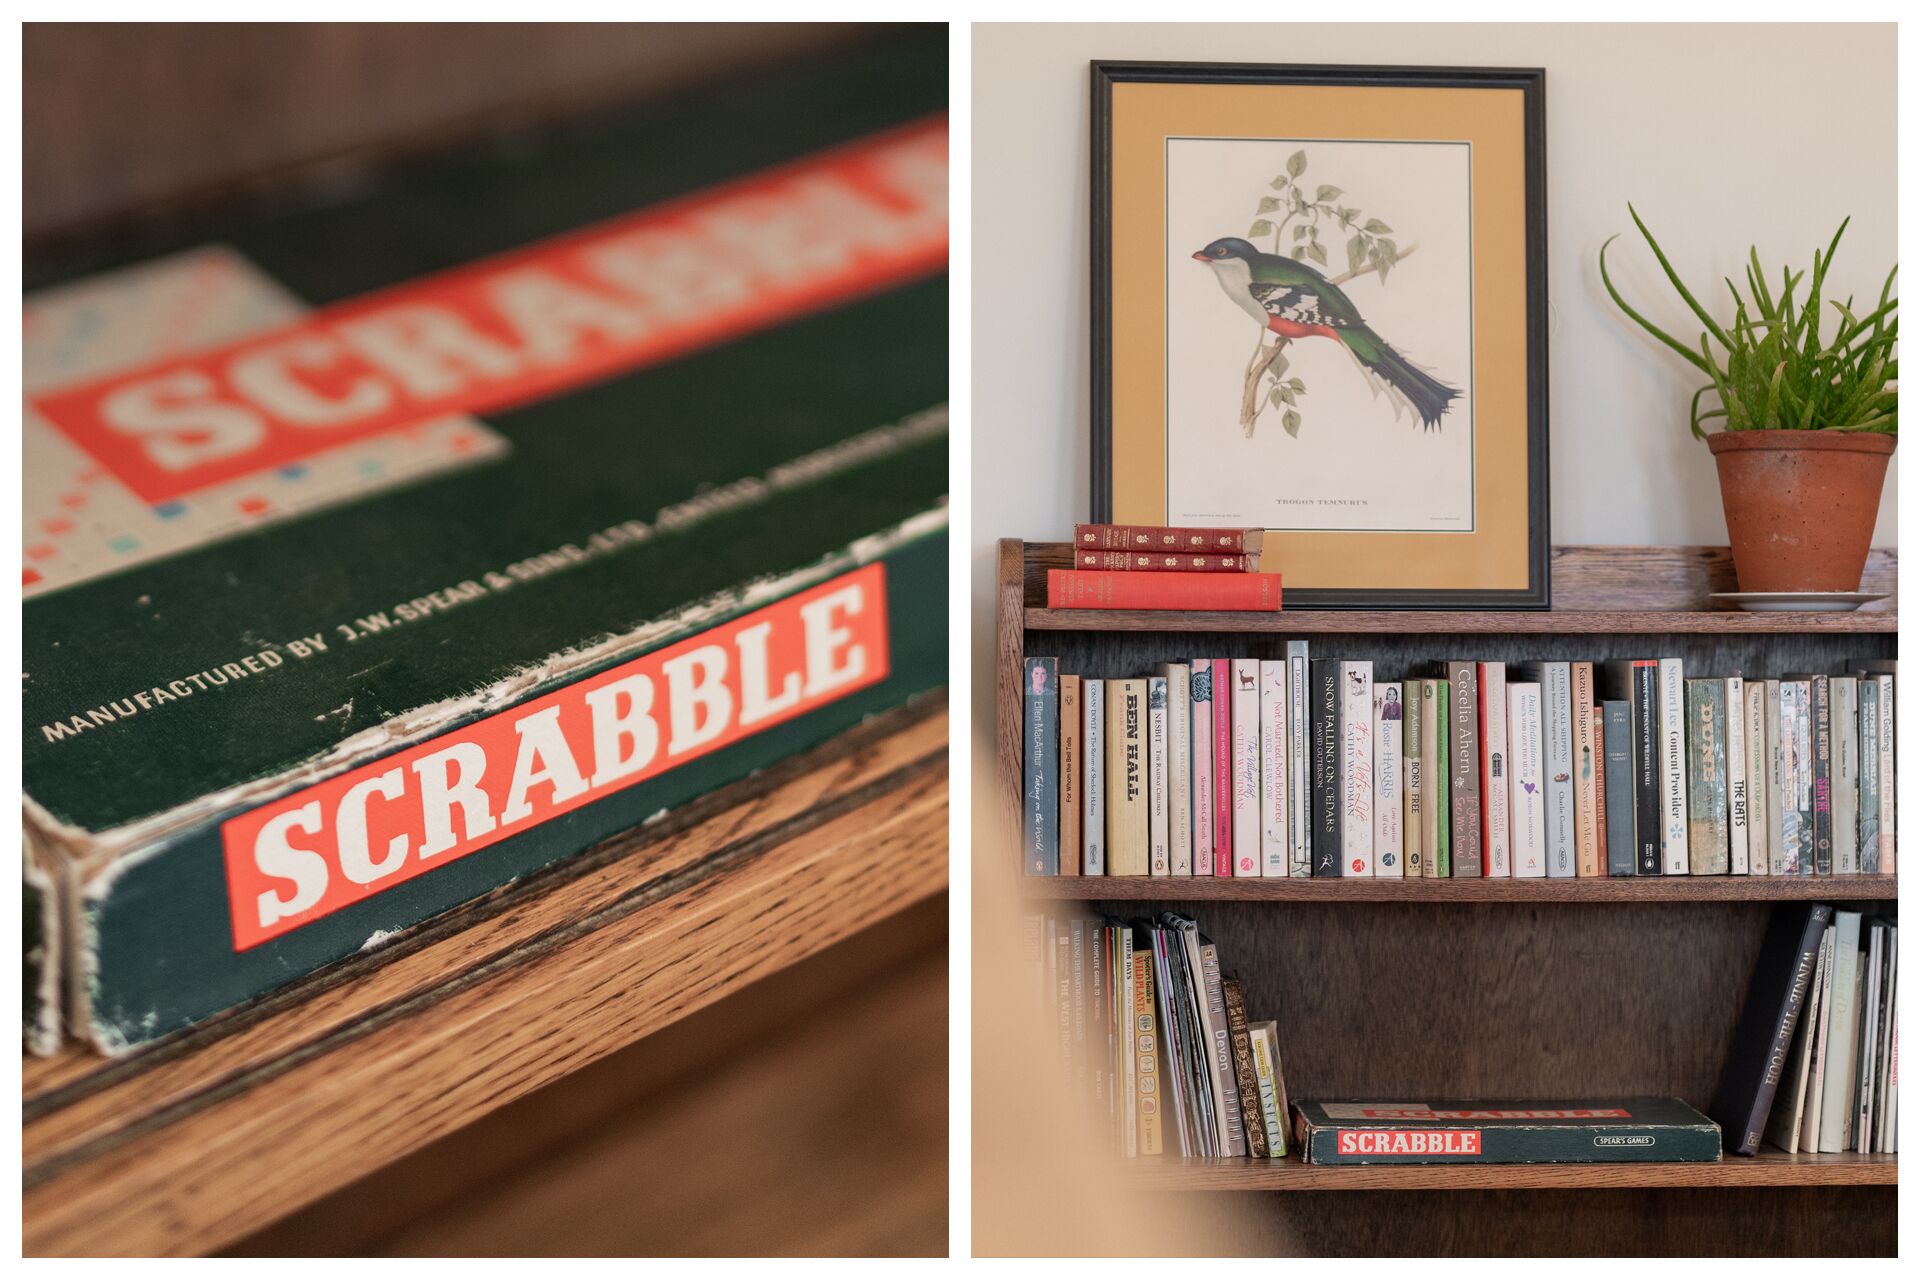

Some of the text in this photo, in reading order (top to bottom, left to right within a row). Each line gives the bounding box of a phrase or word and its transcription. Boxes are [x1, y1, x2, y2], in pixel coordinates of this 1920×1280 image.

[41, 648, 283, 744] MANUFACTURED
[286, 632, 329, 660] BY
[1579, 667, 1587, 699] Kazuo
[1818, 679, 1827, 707] SEARCH
[1883, 682, 1891, 717] William
[1126, 695, 1137, 739] BEN
[1154, 713, 1162, 743] NESBIT
[1410, 698, 1419, 751] Joy Adamson
[1458, 669, 1472, 774] Cecelia Ahern
[1528, 695, 1537, 767] Daily Meditations
[1579, 701, 1588, 743] Ishiguro
[1819, 709, 1827, 722] FOR
[1882, 718, 1891, 752] Golding
[253, 584, 868, 929] SCRABBLE
[1244, 736, 1257, 782] The Village
[1325, 677, 1335, 832] SNOW FALLING ON CEDARS
[1379, 723, 1393, 798] Rosie HARRIS
[1595, 732, 1603, 771] WINSTON
[1668, 665, 1681, 818] Stewart Lee Content Provider
[1701, 704, 1715, 782] DUNE
[1819, 731, 1829, 760] METHOD
[1029, 701, 1043, 825] Ellen MacArthur Taking on the
[1127, 744, 1138, 801] HALL
[1275, 763, 1283, 779] Not
[1884, 775, 1891, 783] of
[1275, 782, 1283, 823] Bothered
[1411, 762, 1419, 814] BORN FREE
[1596, 773, 1604, 821] CHURCHILL
[1734, 780, 1745, 827] THE RATS
[1817, 777, 1827, 812] SARTRE
[1456, 797, 1465, 833] See Me
[1467, 795, 1479, 859] If You Could
[1558, 815, 1566, 844] Connelly
[1584, 828, 1591, 841] Me
[1584, 843, 1591, 857] Go
[1073, 930, 1082, 958] WALKING
[1060, 979, 1069, 996] THE
[1135, 956, 1145, 1012] WILD PLANTS
[1061, 1000, 1070, 1027] WEST
[1764, 951, 1815, 1086] WINNIE THE POOH
[1215, 1030, 1228, 1071] Devon
[1261, 1084, 1280, 1147] INSECTS
[1342, 1133, 1476, 1153] SCRABBLE
[1600, 1136, 1649, 1144] SPEAR'S GAMES
